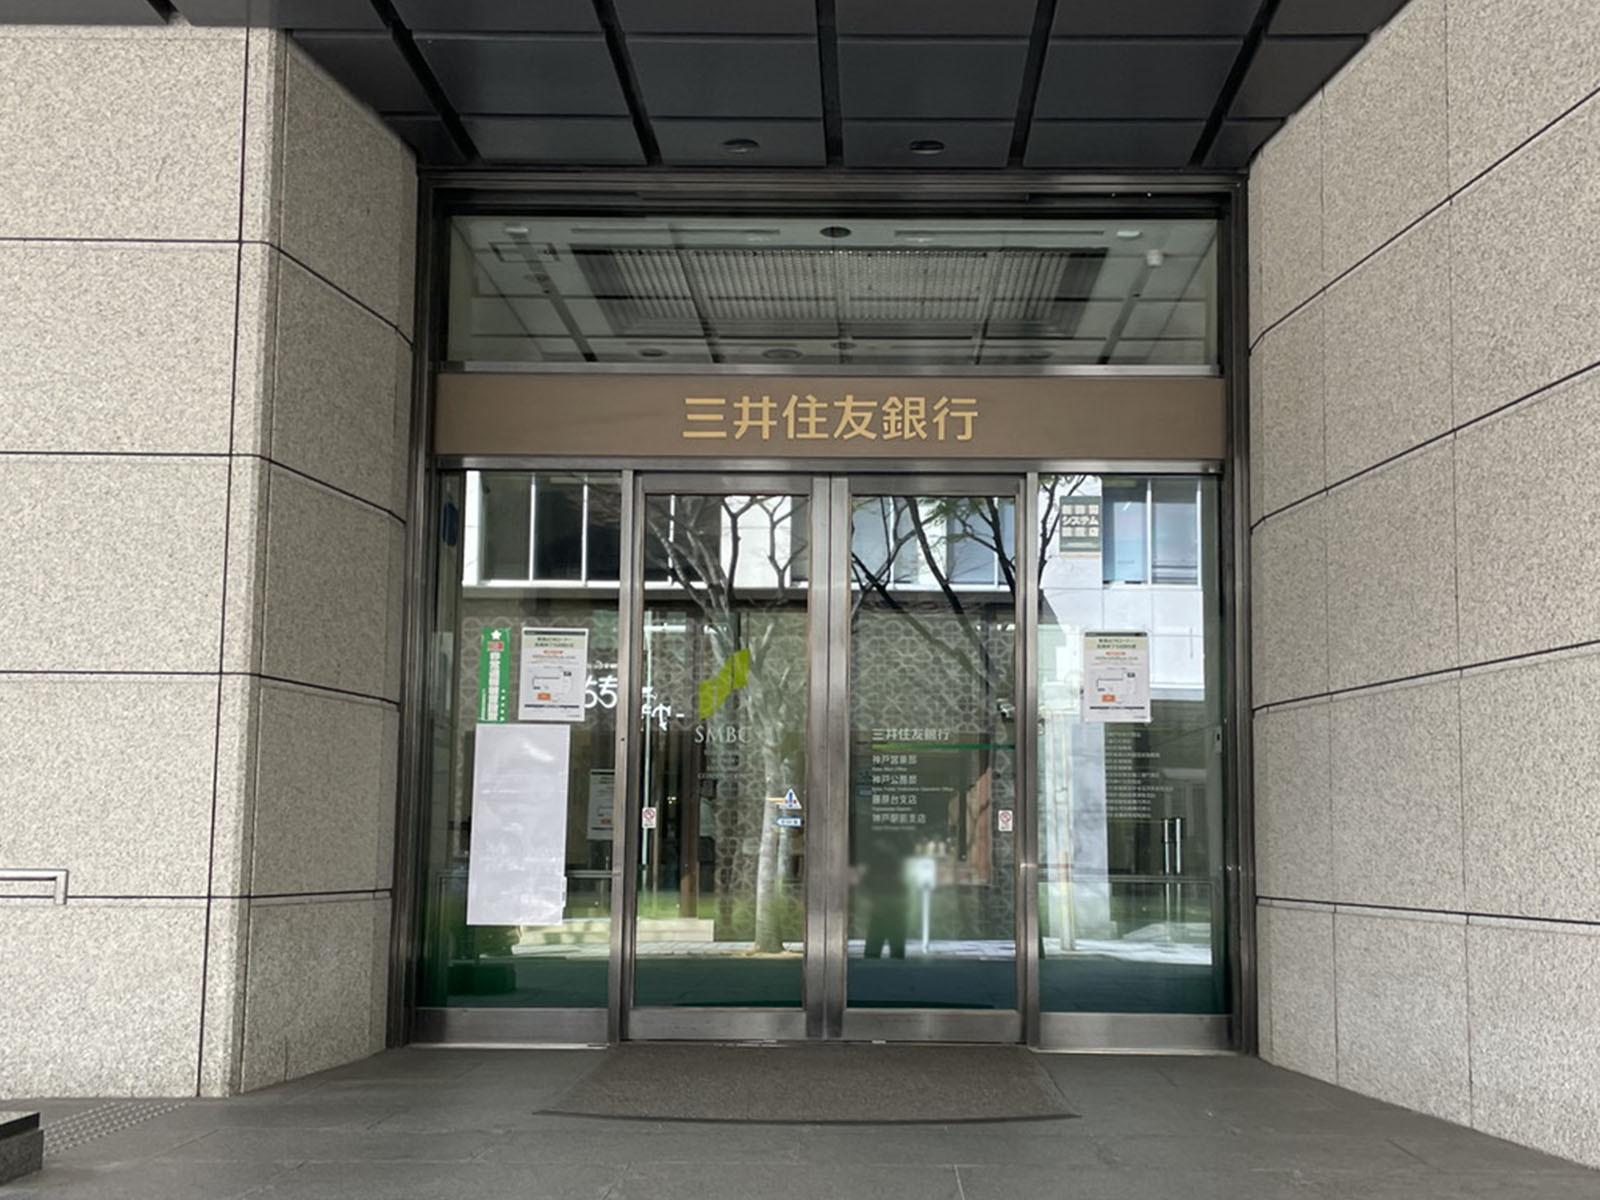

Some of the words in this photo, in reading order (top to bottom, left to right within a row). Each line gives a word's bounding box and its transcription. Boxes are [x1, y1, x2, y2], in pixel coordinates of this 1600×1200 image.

[682, 394, 979, 441] 三井住友銀行
[694, 724, 753, 744] SMBC
[871, 727, 950, 741] 三井住友銀行
